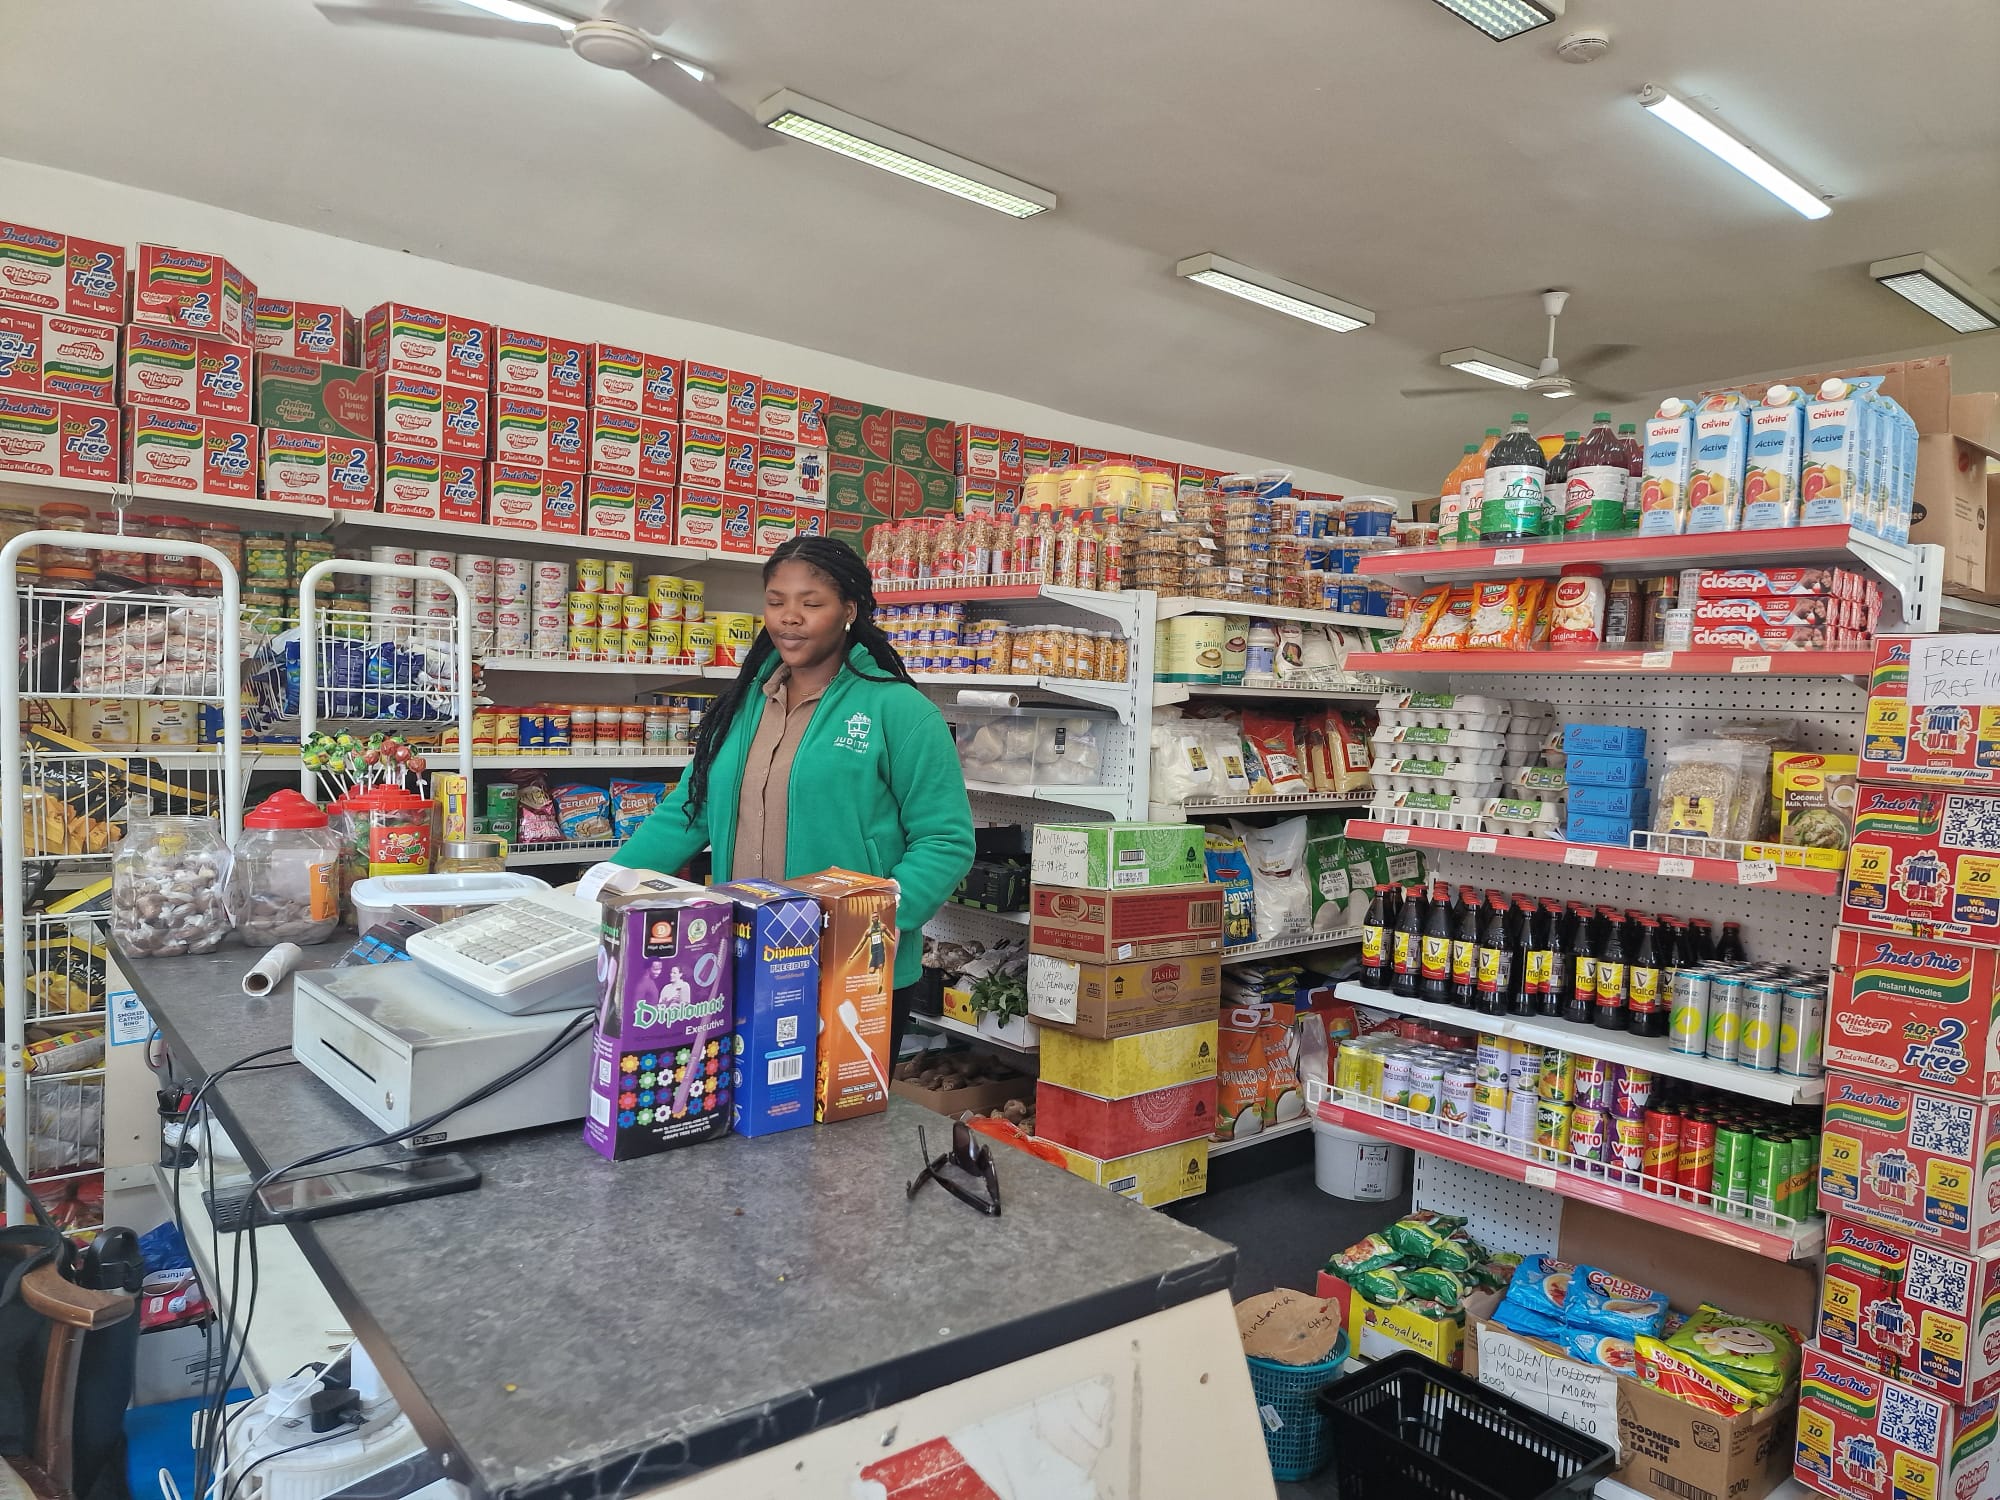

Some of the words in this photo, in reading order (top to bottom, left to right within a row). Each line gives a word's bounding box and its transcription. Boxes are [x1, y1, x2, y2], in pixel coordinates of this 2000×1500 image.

[3, 227, 58, 248] Indomie
[92, 252, 113, 275] 2
[160, 252, 206, 269] Indomie
[3, 266, 51, 283] Chicken
[73, 271, 117, 291] Free
[85, 288, 110, 298] Inside
[141, 292, 172, 303] Chicken
[194, 292, 210, 310] 2
[180, 307, 212, 323] Free
[316, 313, 332, 332] 2
[400, 309, 442, 326] Indomie
[140, 332, 191, 352] Indomie
[300, 331, 335, 346] Free
[466, 328, 482, 348] 2
[400, 341, 437, 356] Chicken
[451, 345, 484, 362] Free
[221, 354, 241, 376] 2
[552, 366, 580, 381] Free
[138, 371, 183, 387] Chicken
[203, 373, 243, 391] Free
[338, 387, 369, 402] Show
[647, 382, 674, 396] Free
[276, 406, 315, 419] Chicken
[282, 398, 311, 410] Onion
[1757, 412, 1789, 426] Chivita
[1813, 407, 1847, 421] Chivita
[86, 417, 108, 438] 2
[147, 414, 198, 432] Indomie
[1651, 426, 1680, 437] Chivita
[1701, 418, 1732, 431] Chivita
[66, 437, 111, 455] Free
[275, 435, 321, 449] Indomie
[1755, 438, 1784, 449] Active
[1811, 432, 1843, 444] Active
[1650, 450, 1677, 459] Active
[1700, 442, 1728, 453] Active
[146, 451, 190, 467] Chicken
[210, 451, 250, 468] Free
[332, 467, 371, 485] Free
[1701, 574, 1767, 592] closeup
[1559, 588, 1581, 596] NOLA
[1697, 603, 1761, 622] closeup
[729, 628, 751, 640] NID
[1428, 636, 1456, 646] GARI
[1470, 633, 1501, 645] GARI
[1694, 630, 1759, 650] closeup
[1879, 711, 1898, 722] 10
[834, 736, 869, 750] JUDITH
[559, 795, 606, 809] CEREVITA
[1790, 792, 1824, 801] Coconut
[1969, 871, 1991, 883] 20
[763, 943, 814, 962] Diplomat
[1863, 942, 1962, 972] Indomie
[770, 960, 810, 973] PRECIOUS
[1879, 981, 1907, 993] Instant
[1908, 985, 1943, 998] Noodles
[634, 993, 725, 1029] Diplomat
[685, 1018, 725, 1035] Executive
[1838, 1013, 1891, 1032] Chicken
[1904, 1023, 1938, 1036] 40+
[1934, 1019, 1966, 1048] 2
[1905, 1044, 1969, 1074] Free
[1920, 1069, 1957, 1084] Inside
[1833, 1086, 1900, 1110] Indomie
[1938, 1176, 1960, 1189] 20
[1832, 1229, 1900, 1259] Indomie
[1590, 1272, 1651, 1297] GOLDEN
[1381, 1317, 1411, 1338] Royal
[1411, 1330, 1433, 1348] Vine
[1484, 1338, 1542, 1367] GOLDEN
[1496, 1361, 1538, 1383] MORN
[1550, 1359, 1600, 1384] GOLDEN
[1654, 1350, 1674, 1369] 50g
[1677, 1361, 1713, 1391] EXTRA
[1716, 1385, 1746, 1407] FREE
[1812, 1363, 1871, 1396] Indomie
[1482, 1372, 1505, 1391] 300g
[1561, 1384, 1596, 1400] MORN
[1620, 1418, 1681, 1449] GOODNESS
[1630, 1431, 1645, 1443] TO
[1648, 1438, 1670, 1454] THE
[1630, 1442, 1668, 1463] EARTH
